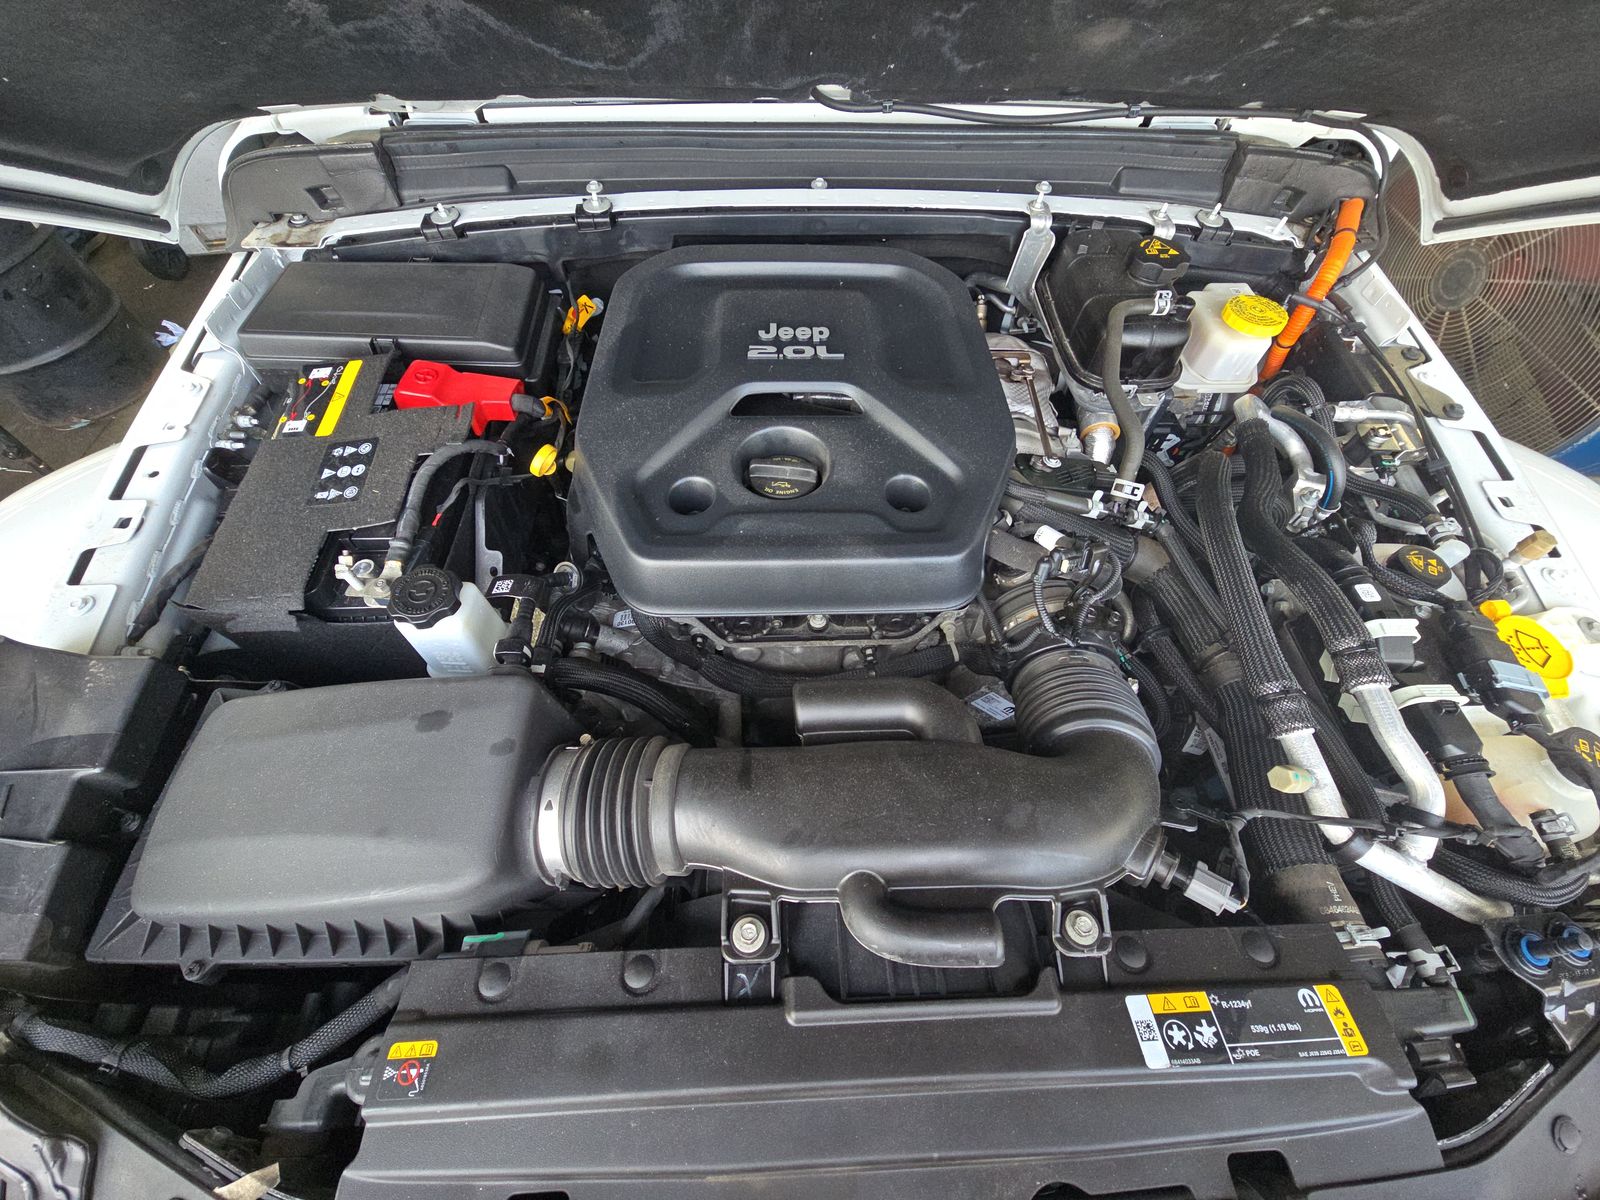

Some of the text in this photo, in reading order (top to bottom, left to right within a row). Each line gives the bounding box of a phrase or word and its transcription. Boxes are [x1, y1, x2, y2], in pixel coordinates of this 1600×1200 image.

[758, 322, 830, 344] Jeep
[747, 345, 845, 360] 2.0L
[764, 486, 799, 495] ENGINE OIL
[1326, 881, 1342, 902] PHEV
[1221, 1000, 1252, 1009] R-1234yf
[1250, 1022, 1302, 1034] 539g (1.19 lbs)
[1245, 1049, 1260, 1057] POE
